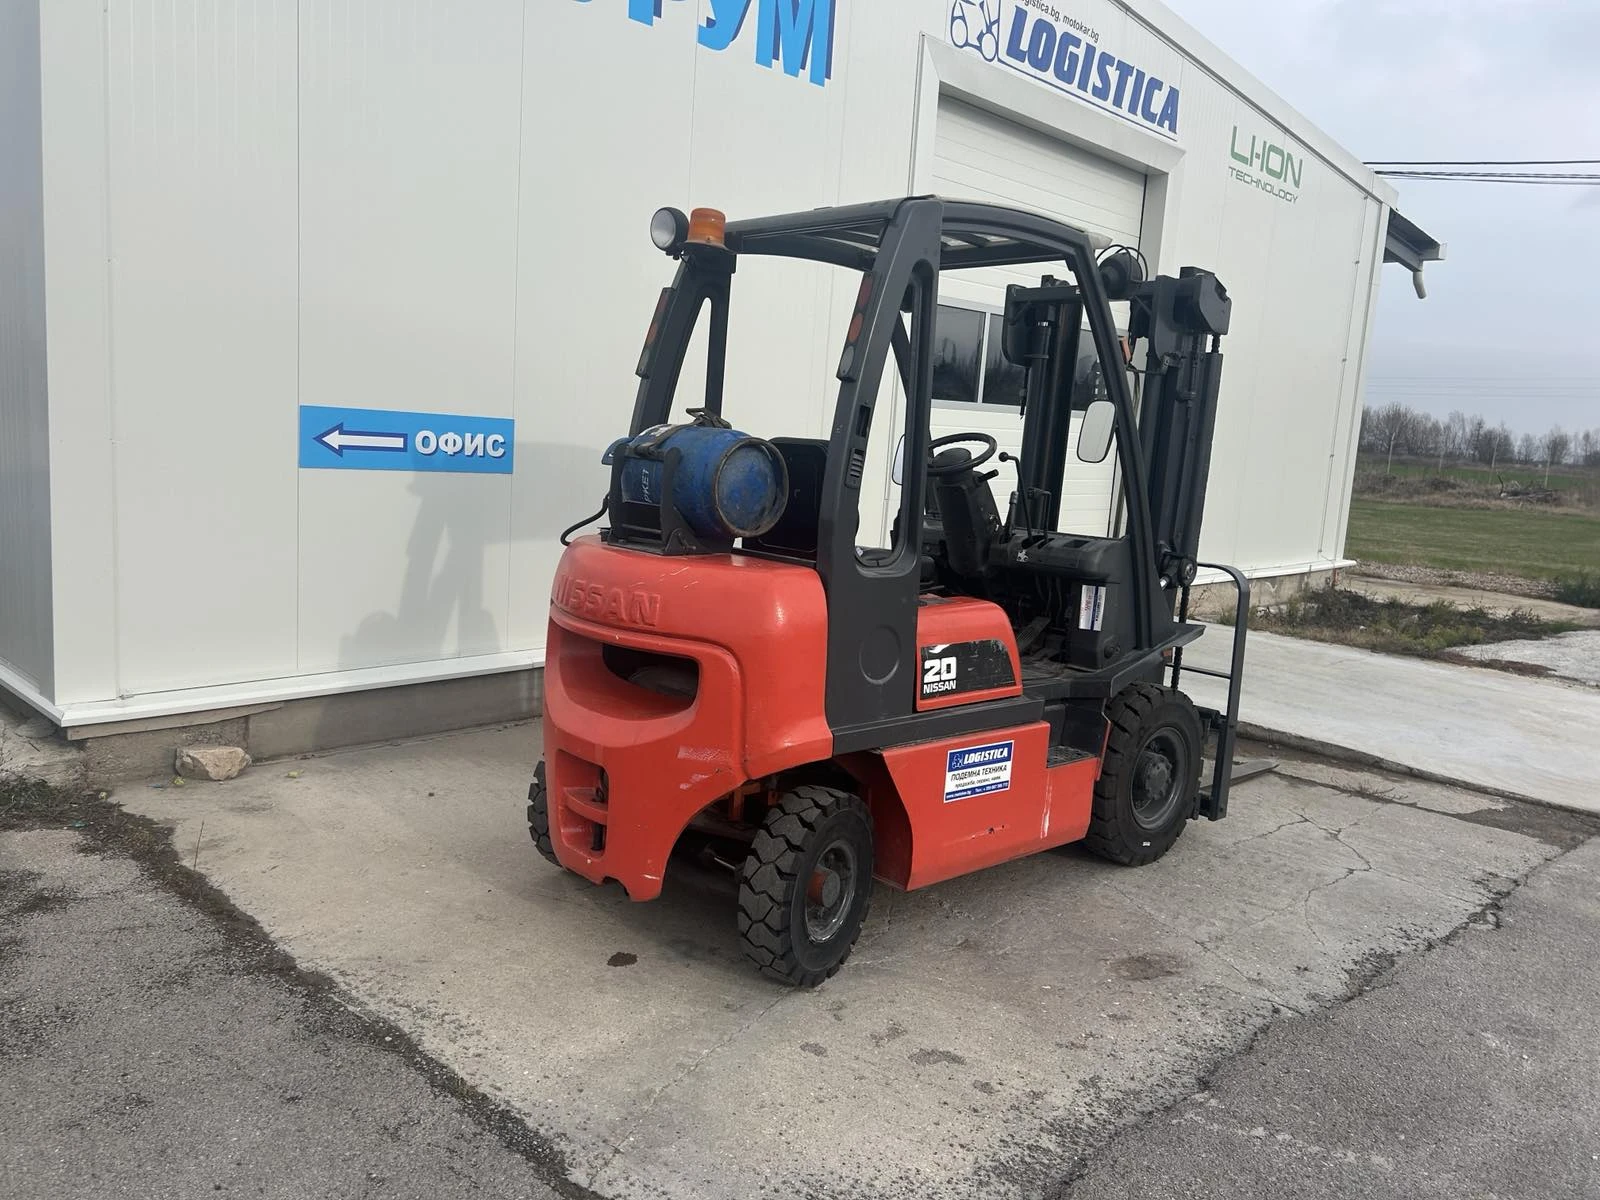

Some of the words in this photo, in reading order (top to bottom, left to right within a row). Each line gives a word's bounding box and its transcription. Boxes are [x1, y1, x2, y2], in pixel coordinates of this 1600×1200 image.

[1021, 0, 1061, 22] gistica.bg,
[1063, 15, 1100, 42] motokar.bg
[1006, 4, 1180, 134] LOGISTICA
[1228, 166, 1298, 204] TECHNOLOGY
[415, 430, 505, 458] ОФИС
[923, 656, 957, 683] 20
[923, 680, 957, 694] NISSAN
[963, 747, 1009, 765] LOGISTICA
[951, 769, 980, 782] ПОДЕМНА
[982, 764, 1007, 776] ТЕХНИКА
